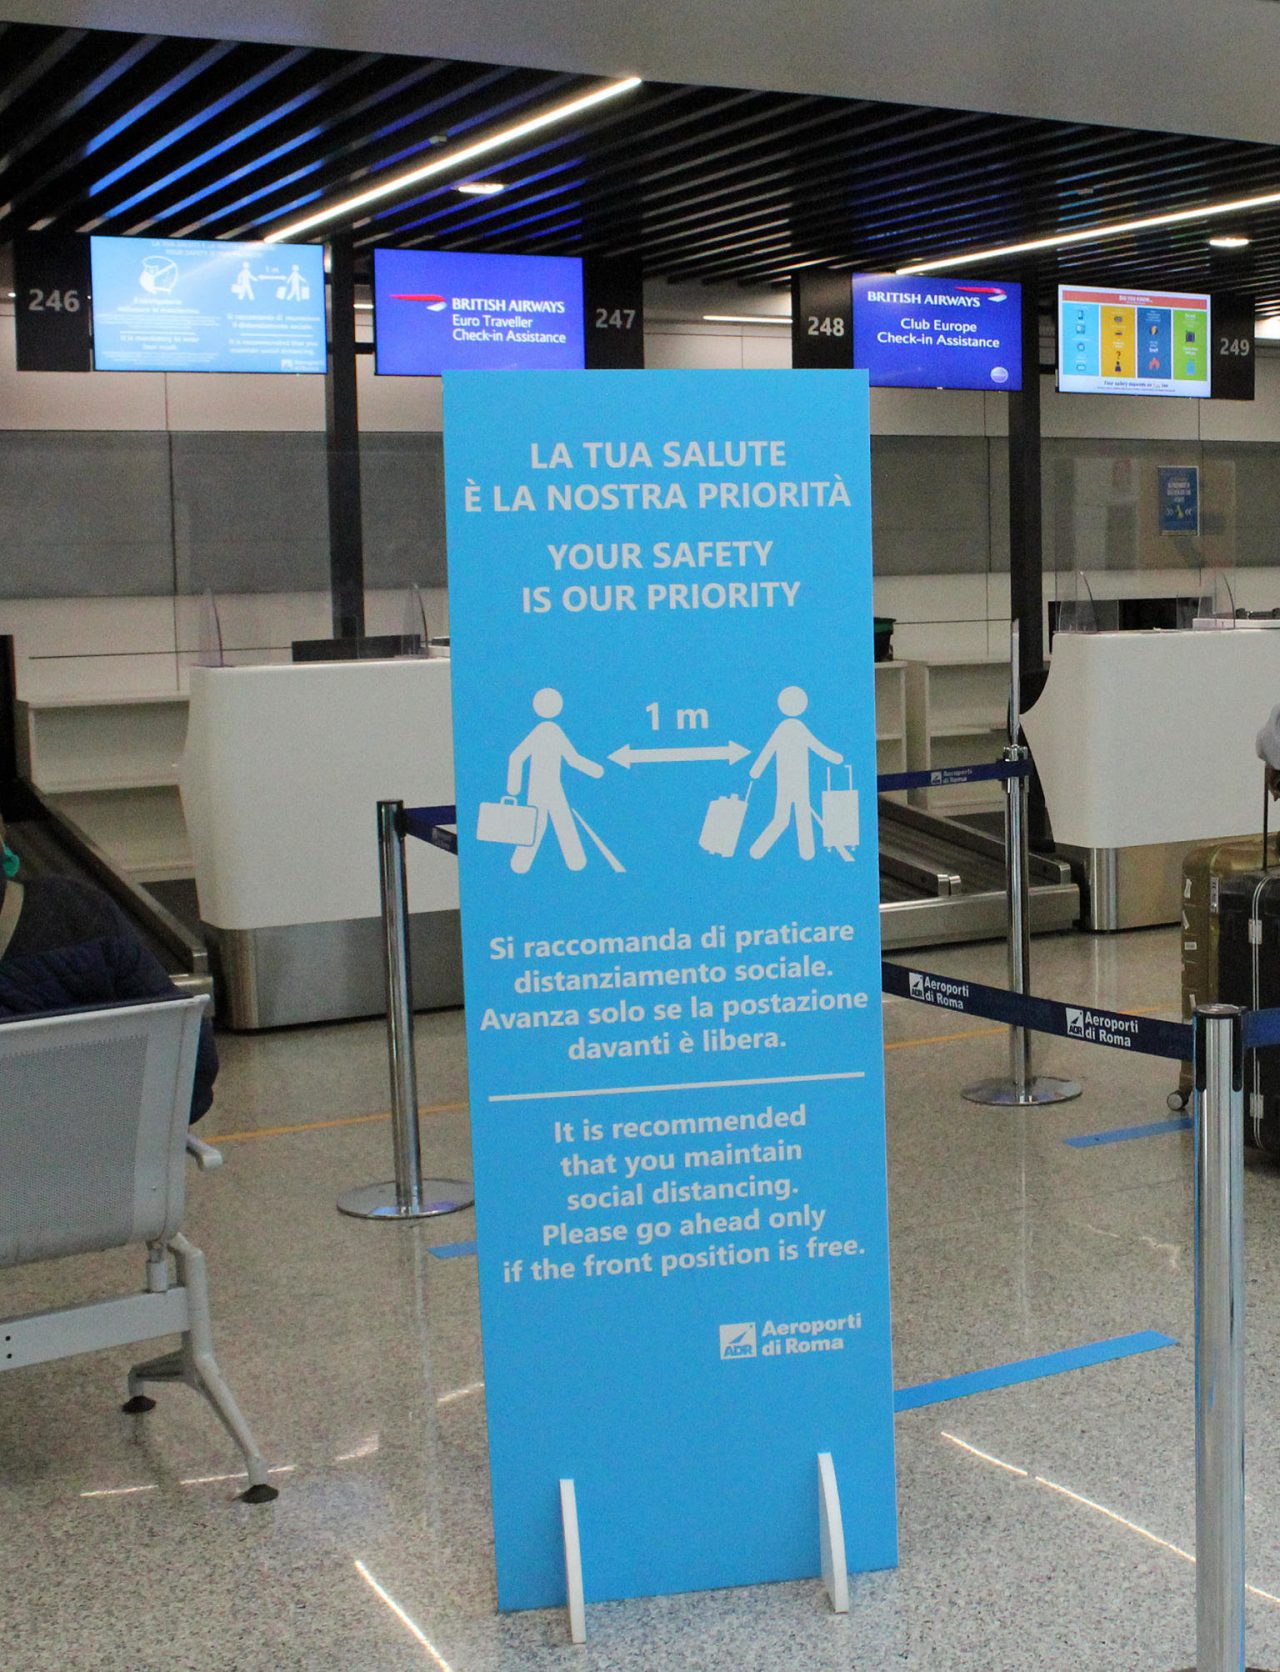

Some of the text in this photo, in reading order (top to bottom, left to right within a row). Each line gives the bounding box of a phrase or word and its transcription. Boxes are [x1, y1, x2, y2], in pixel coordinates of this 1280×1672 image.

[28, 288, 80, 312] 246
[451, 298, 566, 314] BRITISH AIRWAYS
[867, 290, 981, 308] BRITISH AIRWAYS
[452, 314, 533, 328] Euro Traveller
[596, 308, 636, 330] 247
[808, 316, 845, 336] 248
[900, 318, 978, 334] Club Europe
[452, 328, 566, 344] Check-in Assistance
[876, 332, 1000, 348] Check-in Assistance
[1220, 338, 1250, 356] 249
[531, 441, 787, 468] LA TUA SALUTE
[464, 474, 852, 512] È LA NOSTRA PRIORITÀ
[548, 541, 773, 570] YOUR SAFETY
[522, 581, 800, 613] IS OUR PRIORITY
[646, 702, 709, 730] 1 m
[490, 921, 854, 960] Si raccomanda di praticare
[514, 956, 834, 994] distanziamento sociale.
[924, 976, 969, 998] Aeroporti
[480, 988, 869, 1031] Avanza solo se la postazione
[924, 990, 964, 1010] di Roma
[1084, 1010, 1138, 1032] Aeroporti
[568, 1028, 786, 1060] davanti è libera.
[1086, 1027, 1132, 1047] di Roma
[554, 1104, 806, 1144] It is recommended
[560, 1140, 803, 1178] that you maintain
[567, 1175, 800, 1210] social distancing.
[542, 1204, 827, 1246] Please go ahead only
[504, 1237, 866, 1284] if the front position is free.
[762, 1312, 862, 1338] Aeroporti
[724, 1344, 754, 1358] ADR
[762, 1336, 844, 1357] di Roma
